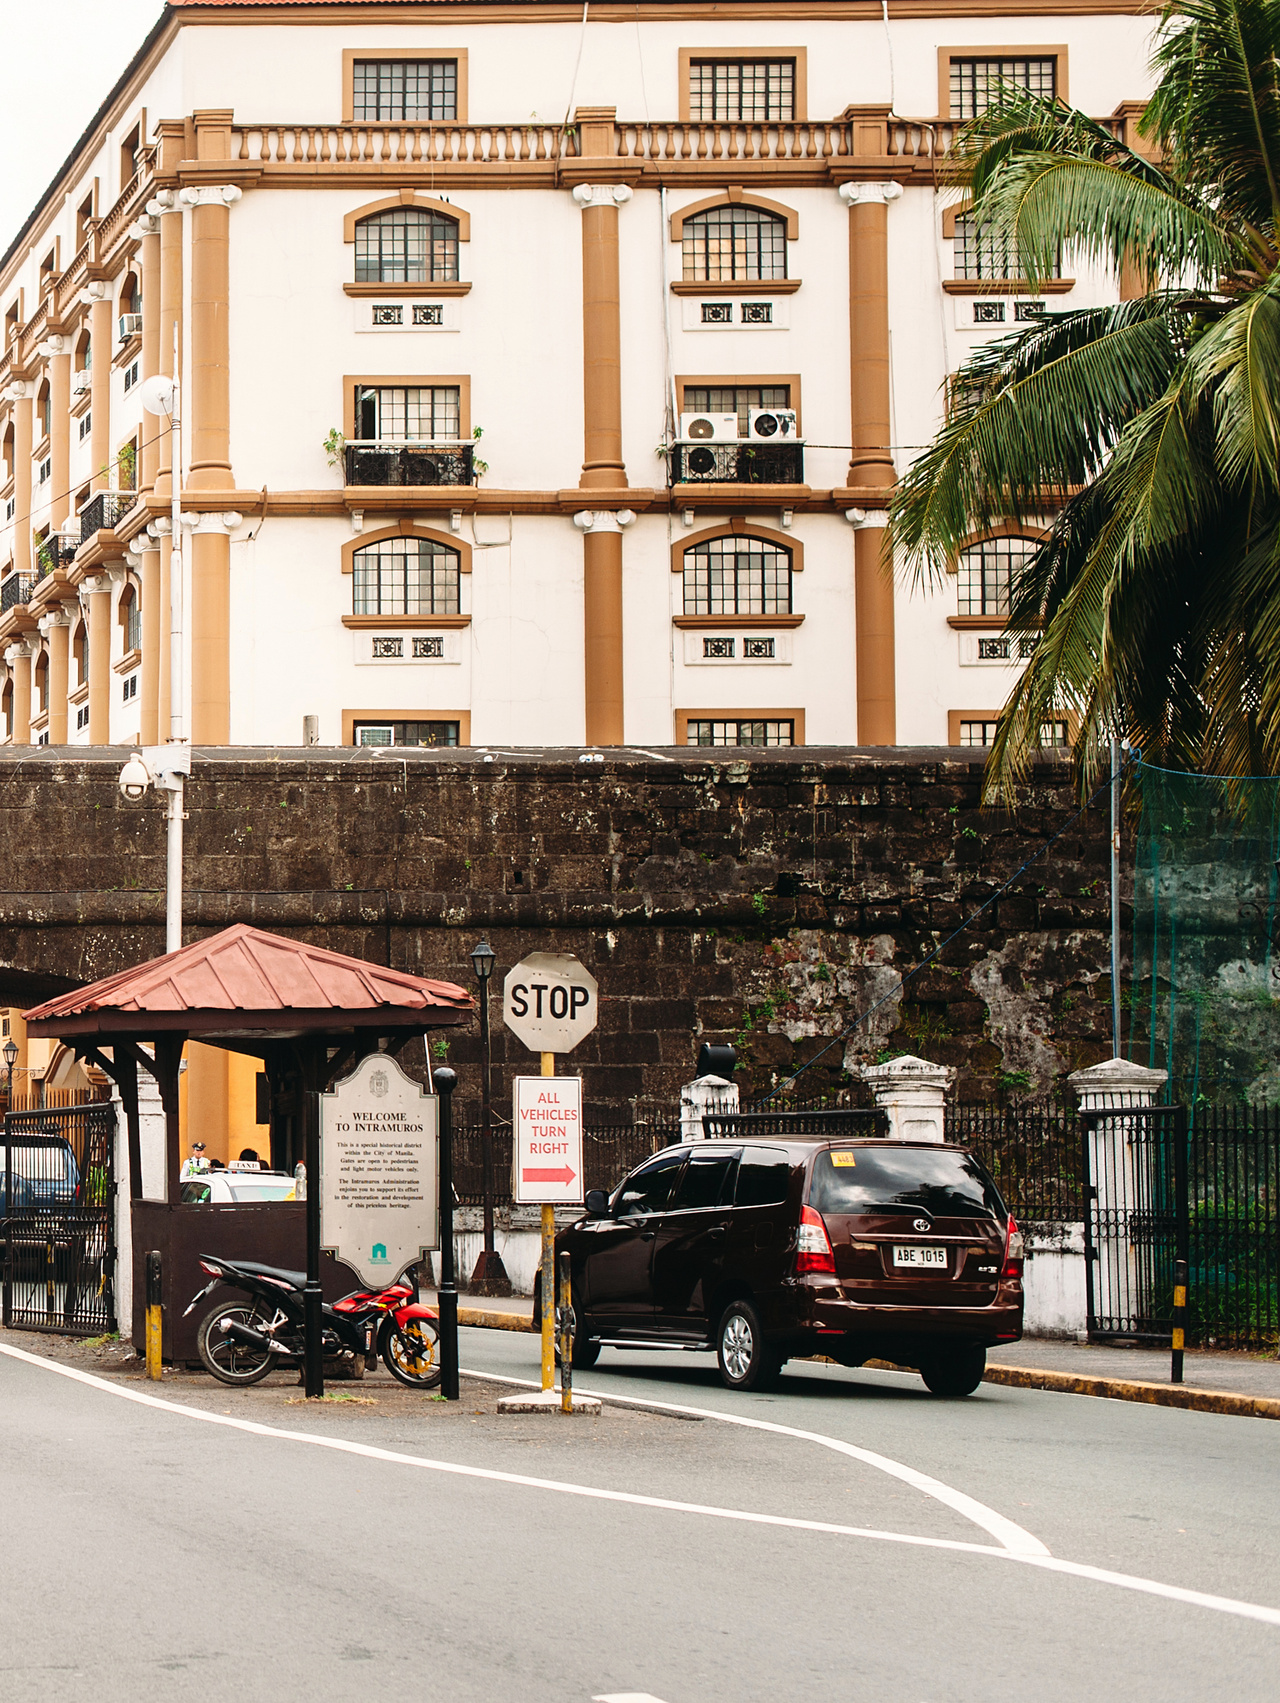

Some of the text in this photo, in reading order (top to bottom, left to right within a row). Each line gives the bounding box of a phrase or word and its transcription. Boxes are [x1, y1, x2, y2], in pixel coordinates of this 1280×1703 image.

[511, 984, 589, 1020] STOP
[538, 1092, 560, 1104] ALL
[353, 1112, 407, 1121] WELCOME
[520, 1109, 578, 1120] VEHICLES
[336, 1123, 423, 1132] TO INTRAMUROS
[531, 1126, 566, 1137] TURN
[530, 1143, 569, 1154] RIGHT
[898, 1250, 944, 1262] ABE 1015
